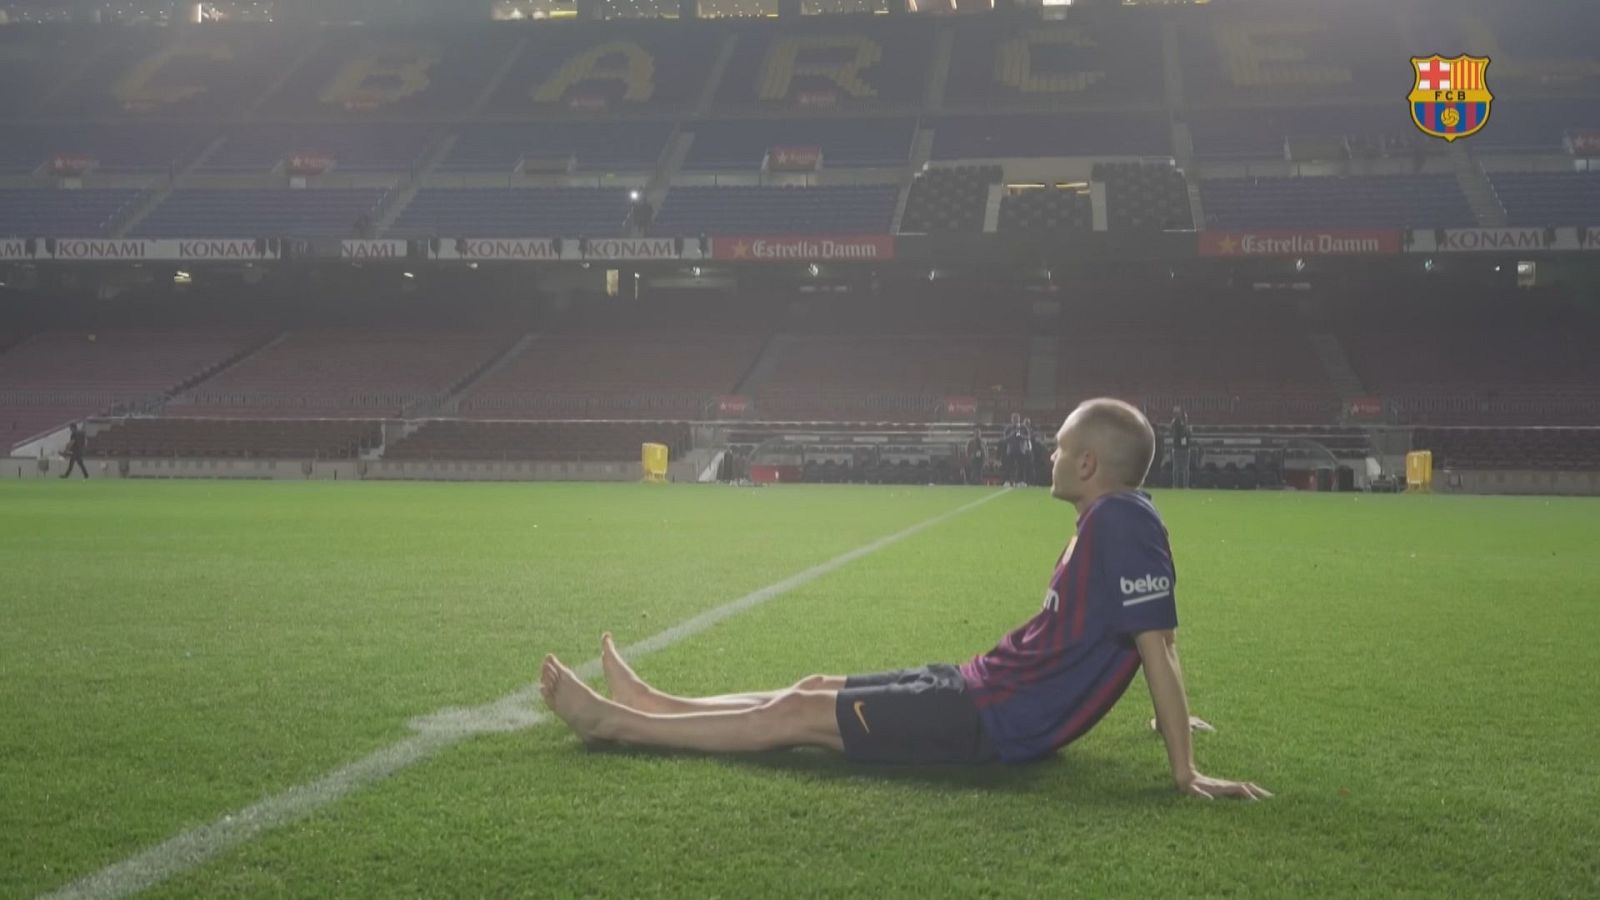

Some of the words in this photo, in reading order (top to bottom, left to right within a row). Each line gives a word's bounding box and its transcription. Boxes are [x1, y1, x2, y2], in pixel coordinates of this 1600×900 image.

[58, 241, 145, 257] KONAMI
[178, 241, 265, 257] KONAM
[463, 240, 553, 257] KONAMI
[752, 239, 819, 258] Estrella
[821, 239, 877, 258] Damm
[1241, 234, 1314, 254] Estrella
[1316, 234, 1379, 254] Damm
[1119, 573, 1170, 595] beko
